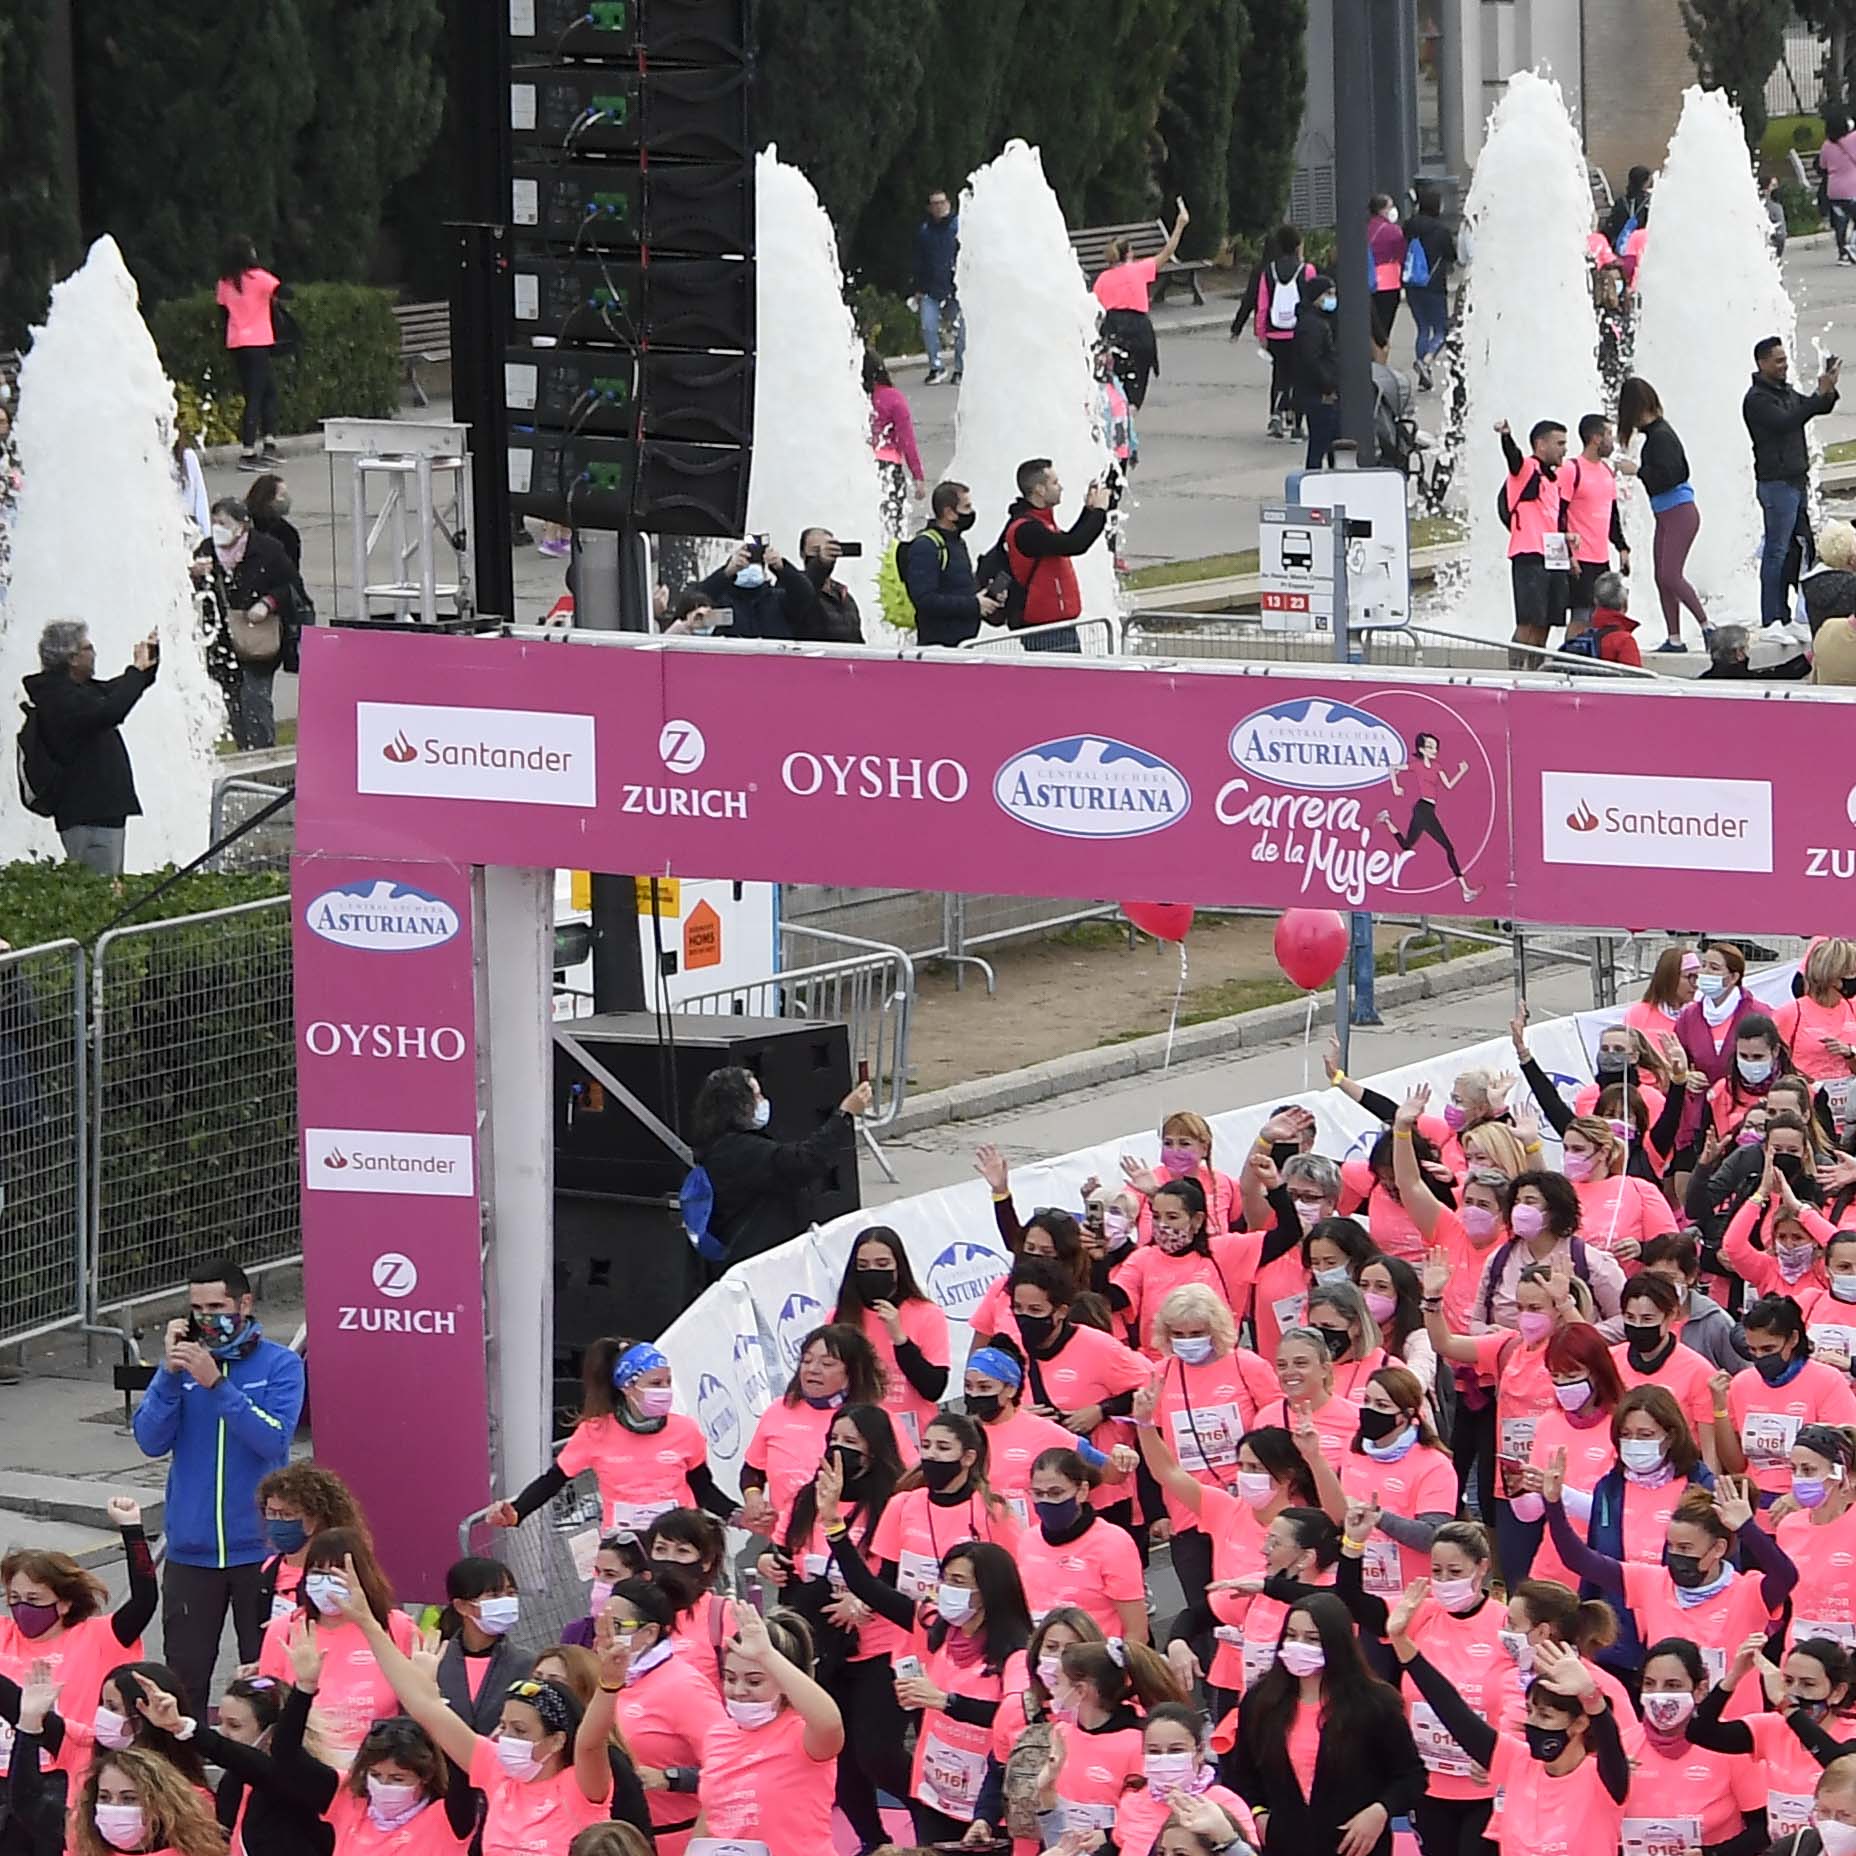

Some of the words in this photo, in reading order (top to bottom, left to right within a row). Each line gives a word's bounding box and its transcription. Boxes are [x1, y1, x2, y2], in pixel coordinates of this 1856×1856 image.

[1267, 596, 1281, 608] 13
[1290, 597, 1305, 609] 23
[424, 738, 573, 772] Santander
[1243, 729, 1390, 768] ASTURIANA
[782, 752, 968, 802] OYSHO
[1009, 771, 1173, 813] ASTURIANA
[621, 785, 748, 819] ZURICH
[1215, 779, 1361, 831] Carrera
[1605, 807, 1748, 839] Santander
[1252, 830, 1279, 862] de
[1284, 831, 1304, 864] la
[1301, 827, 1415, 905] Mujer
[318, 903, 450, 936] ASTURIANA
[306, 1021, 466, 1061] OYSHO
[352, 1152, 456, 1174] Santander
[338, 1307, 455, 1334] ZURICH
[1757, 1438, 1780, 1448] 016
